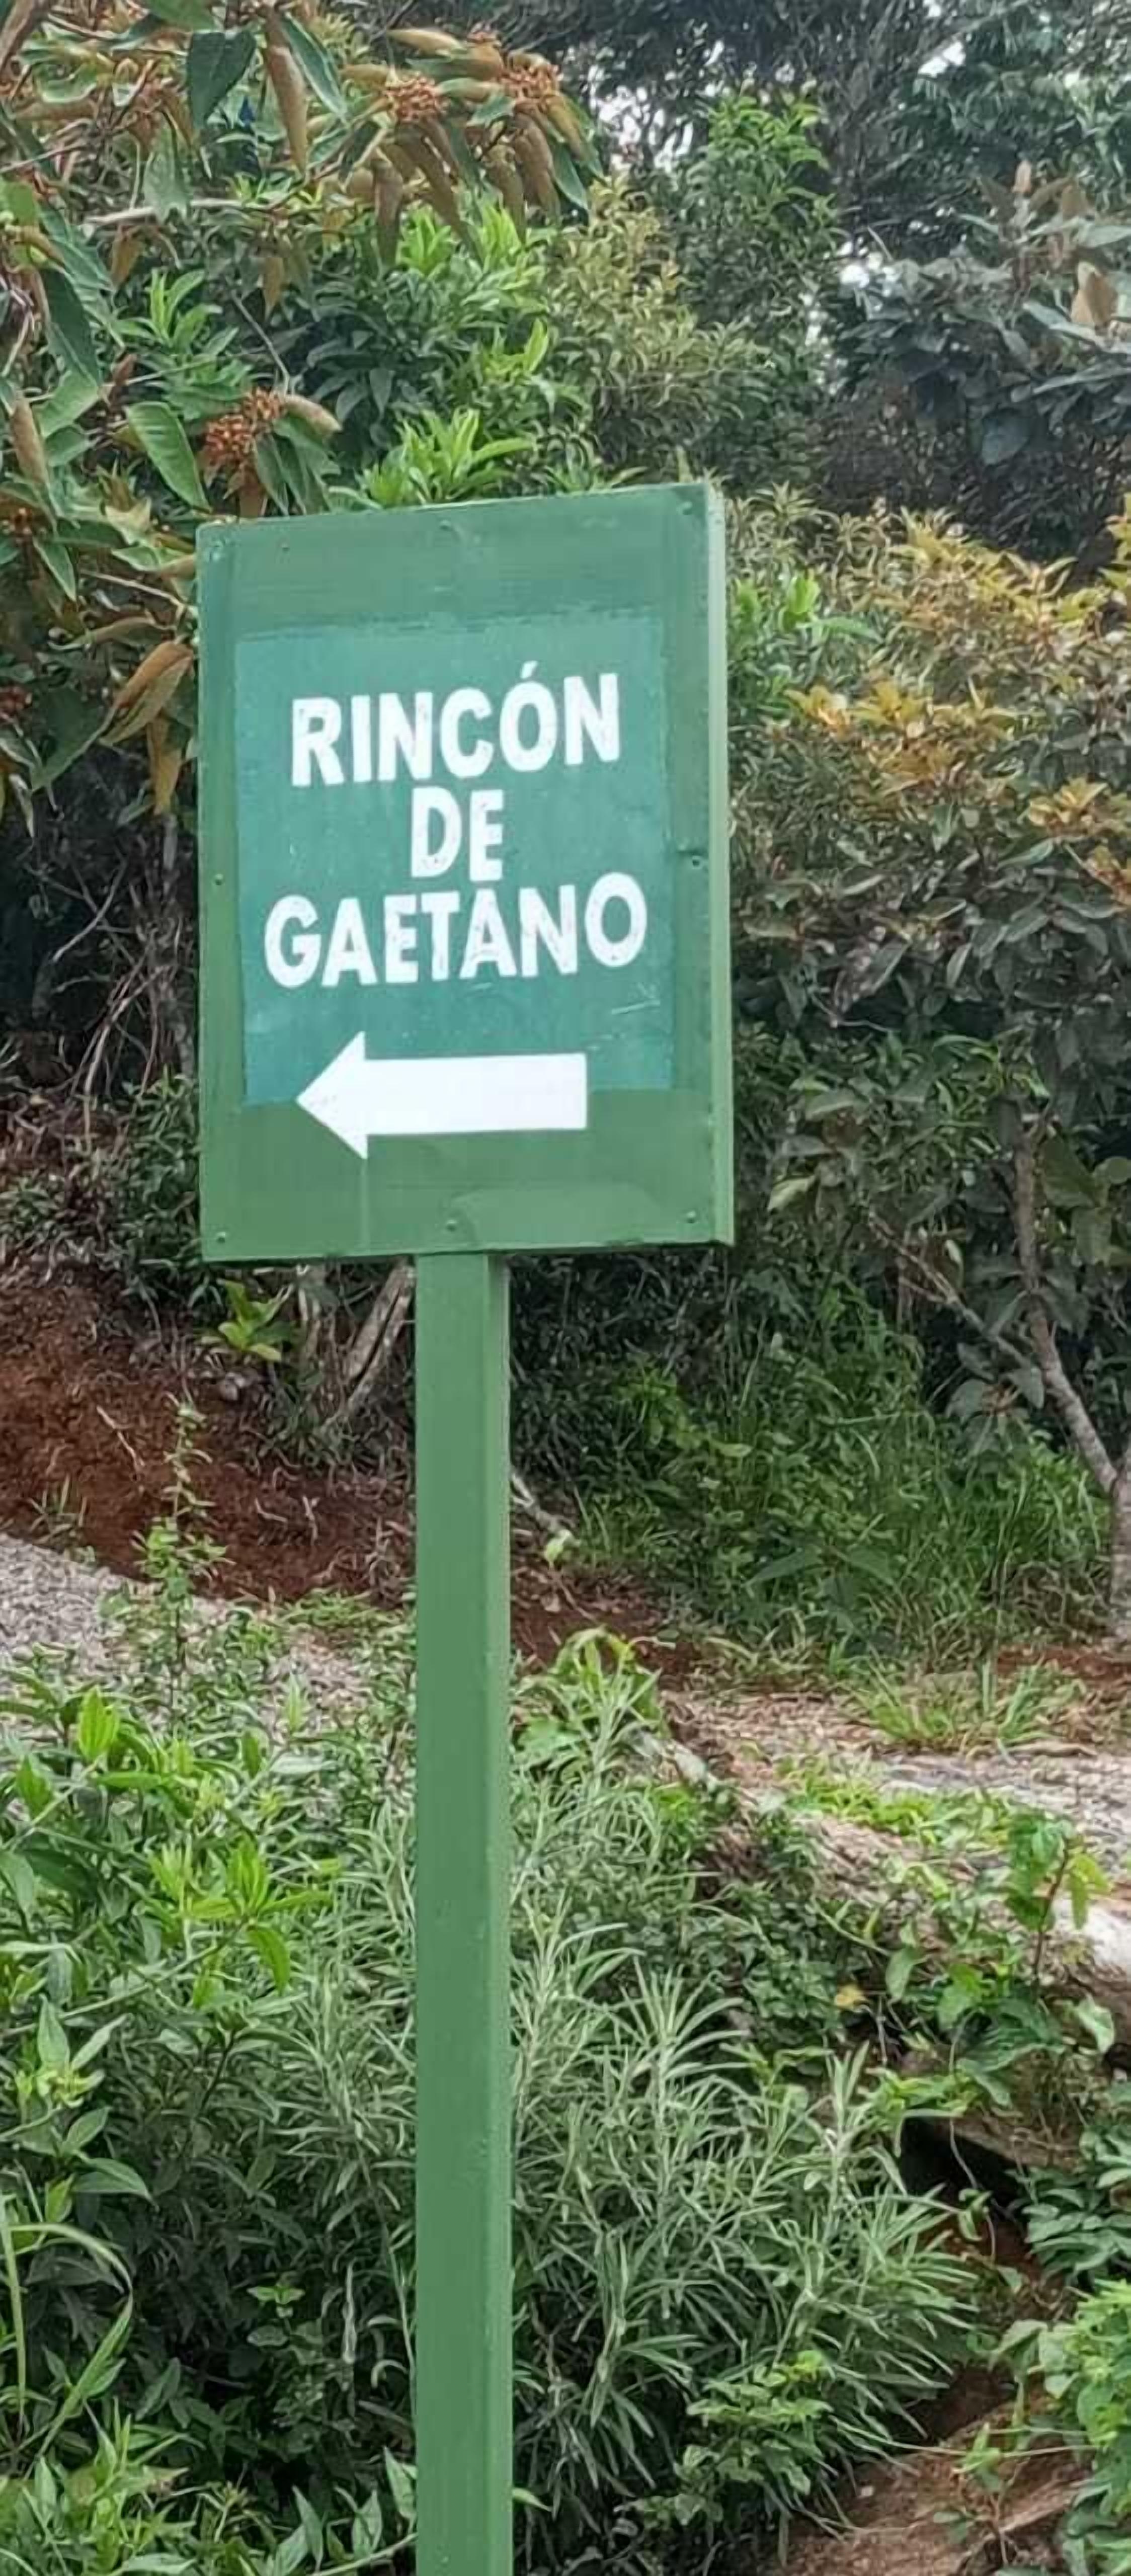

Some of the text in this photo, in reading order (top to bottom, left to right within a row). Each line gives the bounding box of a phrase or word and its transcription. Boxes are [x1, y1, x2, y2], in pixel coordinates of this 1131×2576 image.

[291, 660, 621, 787] RINCÓN
[410, 786, 504, 882] DE
[264, 871, 648, 988] GAETANO
